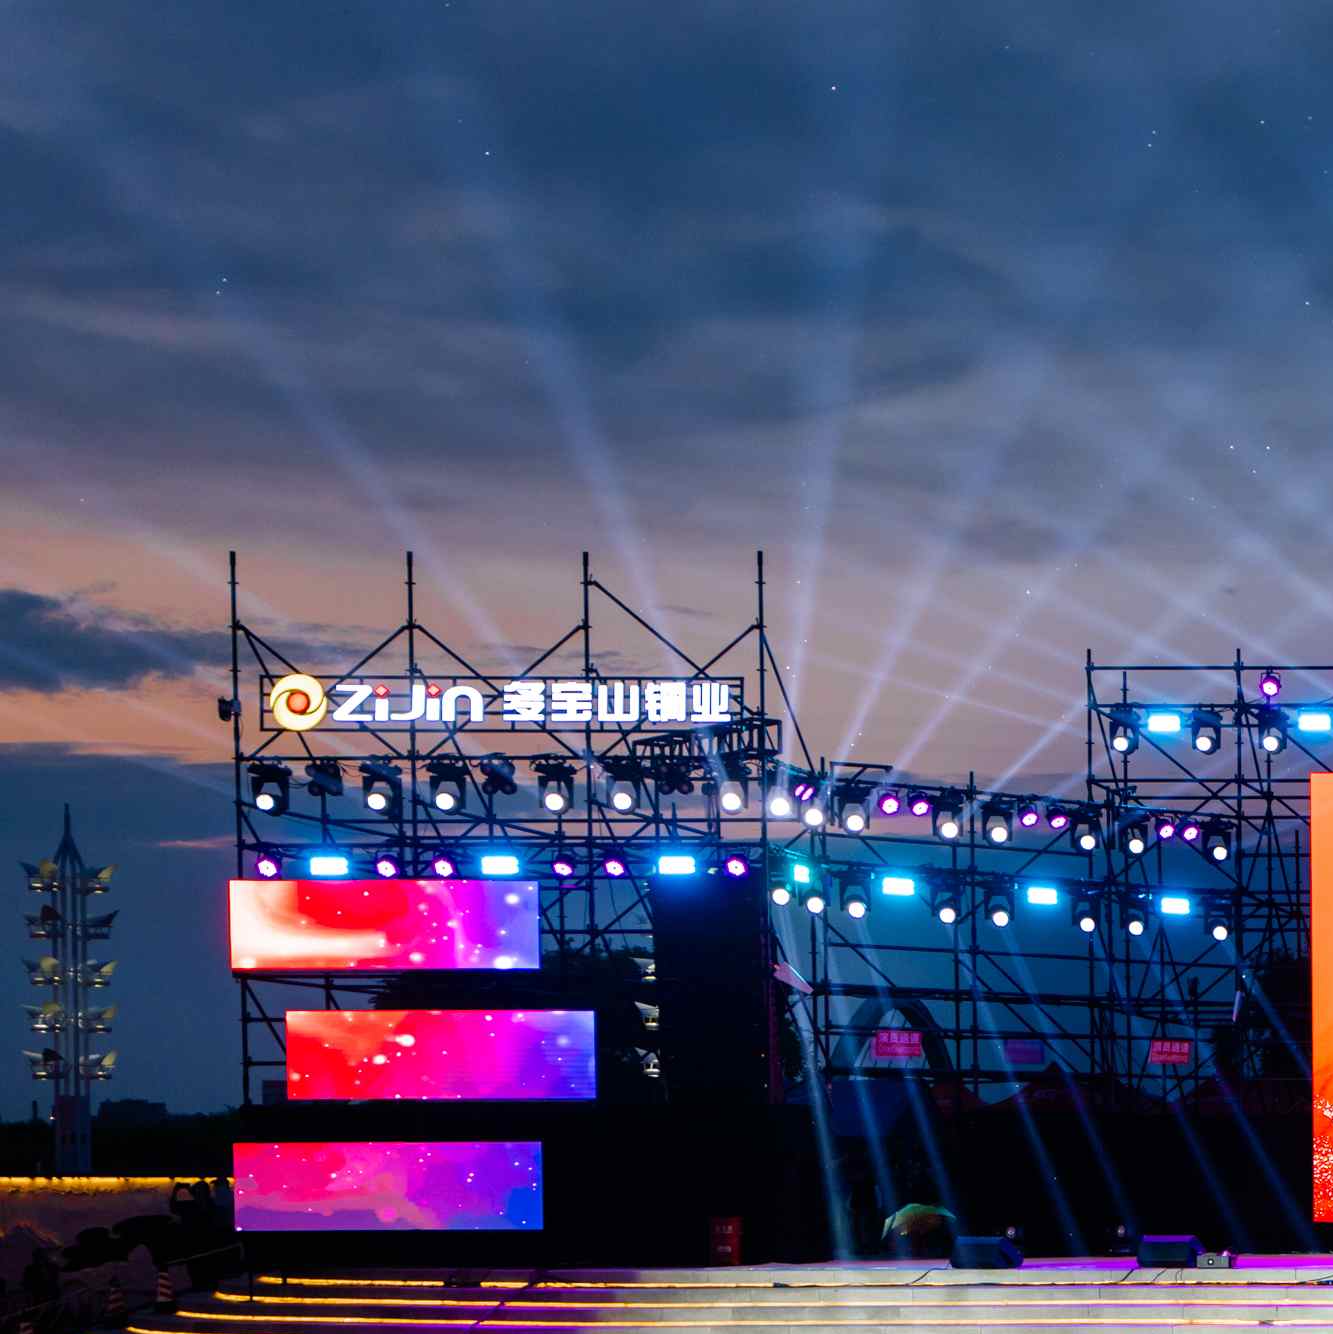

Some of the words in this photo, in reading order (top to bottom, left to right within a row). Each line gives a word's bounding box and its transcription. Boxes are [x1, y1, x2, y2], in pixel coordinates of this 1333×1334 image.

[503, 681, 731, 722] 多宝山铜业
